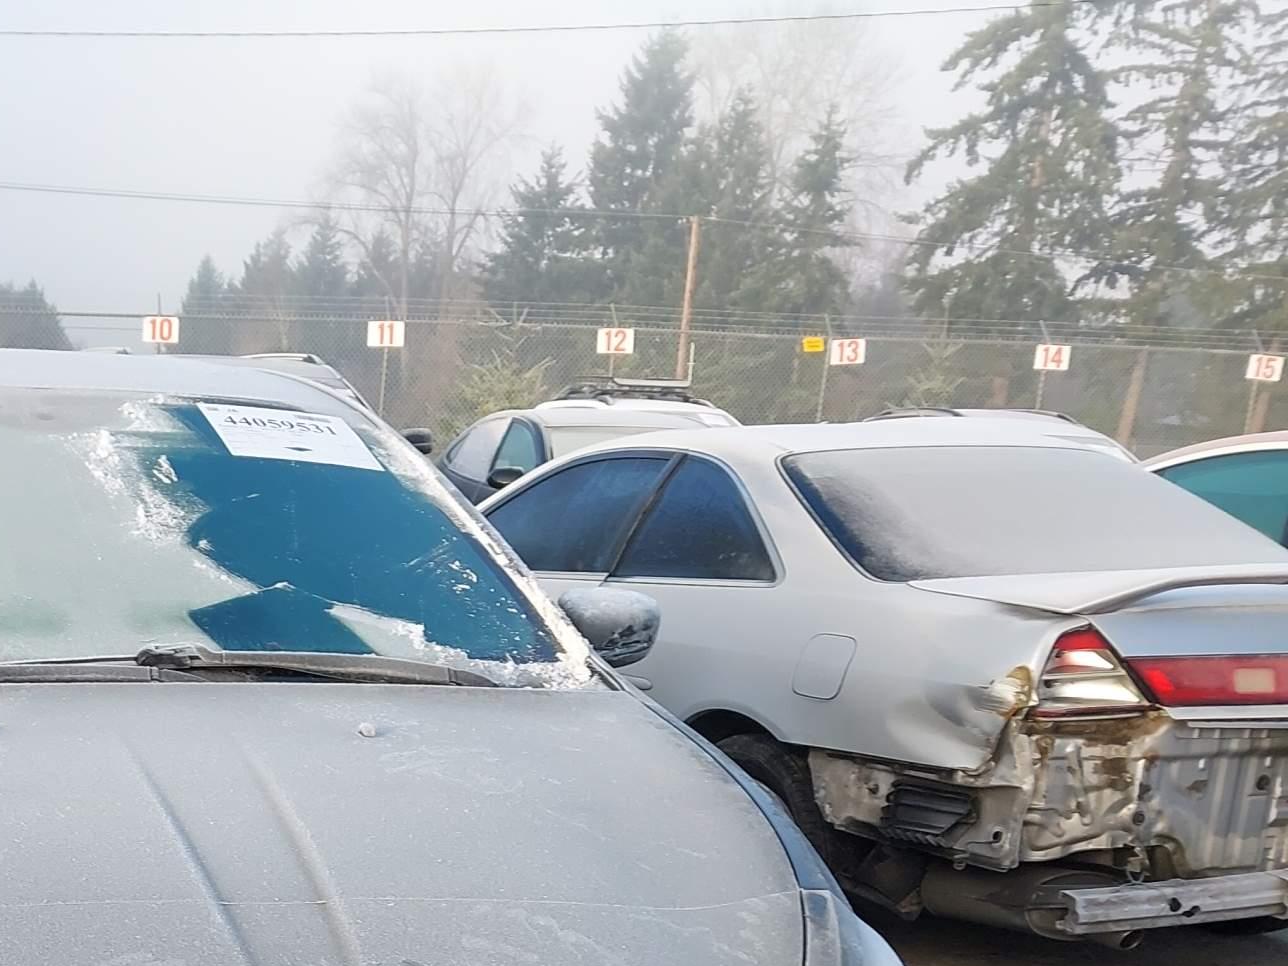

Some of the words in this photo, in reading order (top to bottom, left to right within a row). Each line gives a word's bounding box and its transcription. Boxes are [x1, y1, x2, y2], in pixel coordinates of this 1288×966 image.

[150, 318, 172, 342] 10
[378, 322, 394, 344] 11
[605, 329, 626, 352] 12
[838, 340, 859, 363] 13
[1043, 346, 1063, 368] 14
[1256, 357, 1279, 379] 15
[224, 415, 337, 436] 44059531
